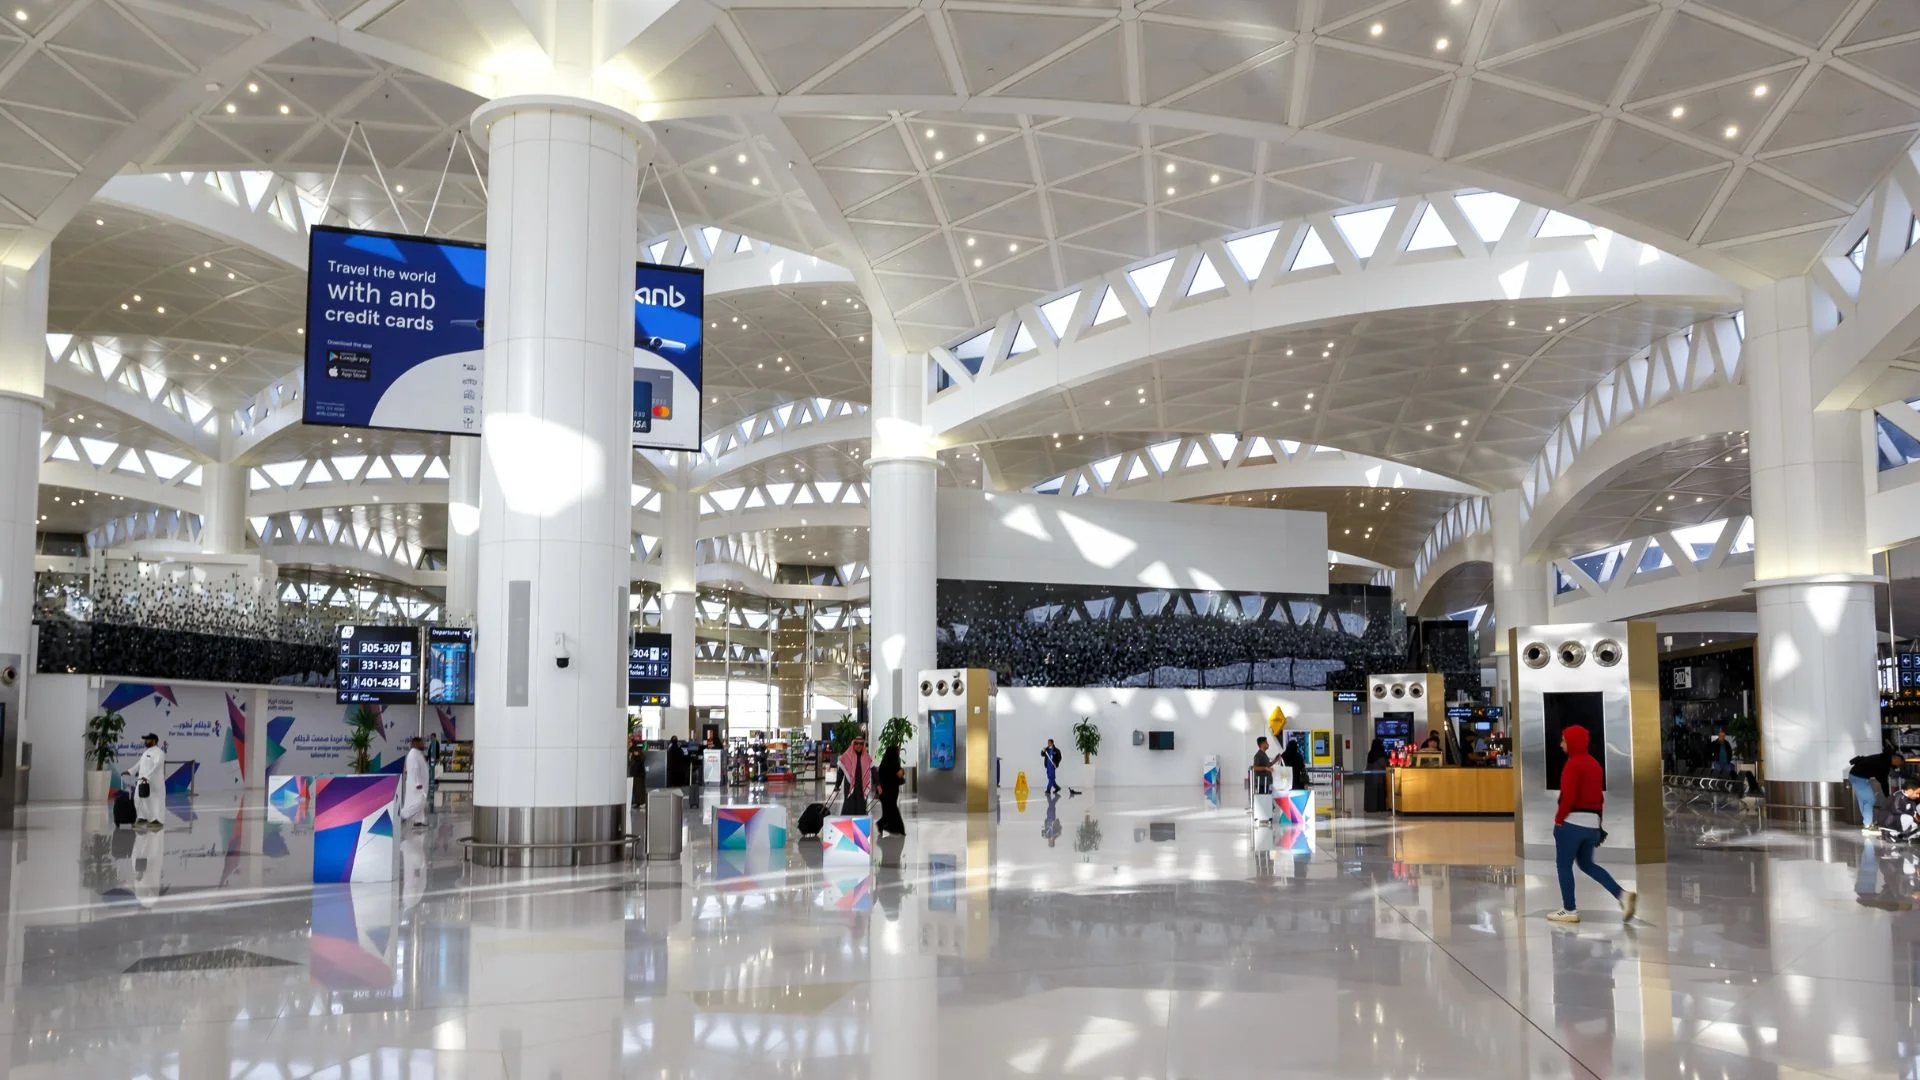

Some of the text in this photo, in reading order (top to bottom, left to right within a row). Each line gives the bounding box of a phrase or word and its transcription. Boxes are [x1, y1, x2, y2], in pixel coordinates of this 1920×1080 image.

[328, 260, 436, 283] Travel the world
[328, 281, 436, 310] with anb
[635, 285, 686, 308] anb
[325, 309, 434, 331] credit cards
[633, 420, 647, 428] ISA
[361, 643, 400, 653] 305-307
[361, 661, 400, 670] 331-334
[360, 677, 400, 687] 401-434
